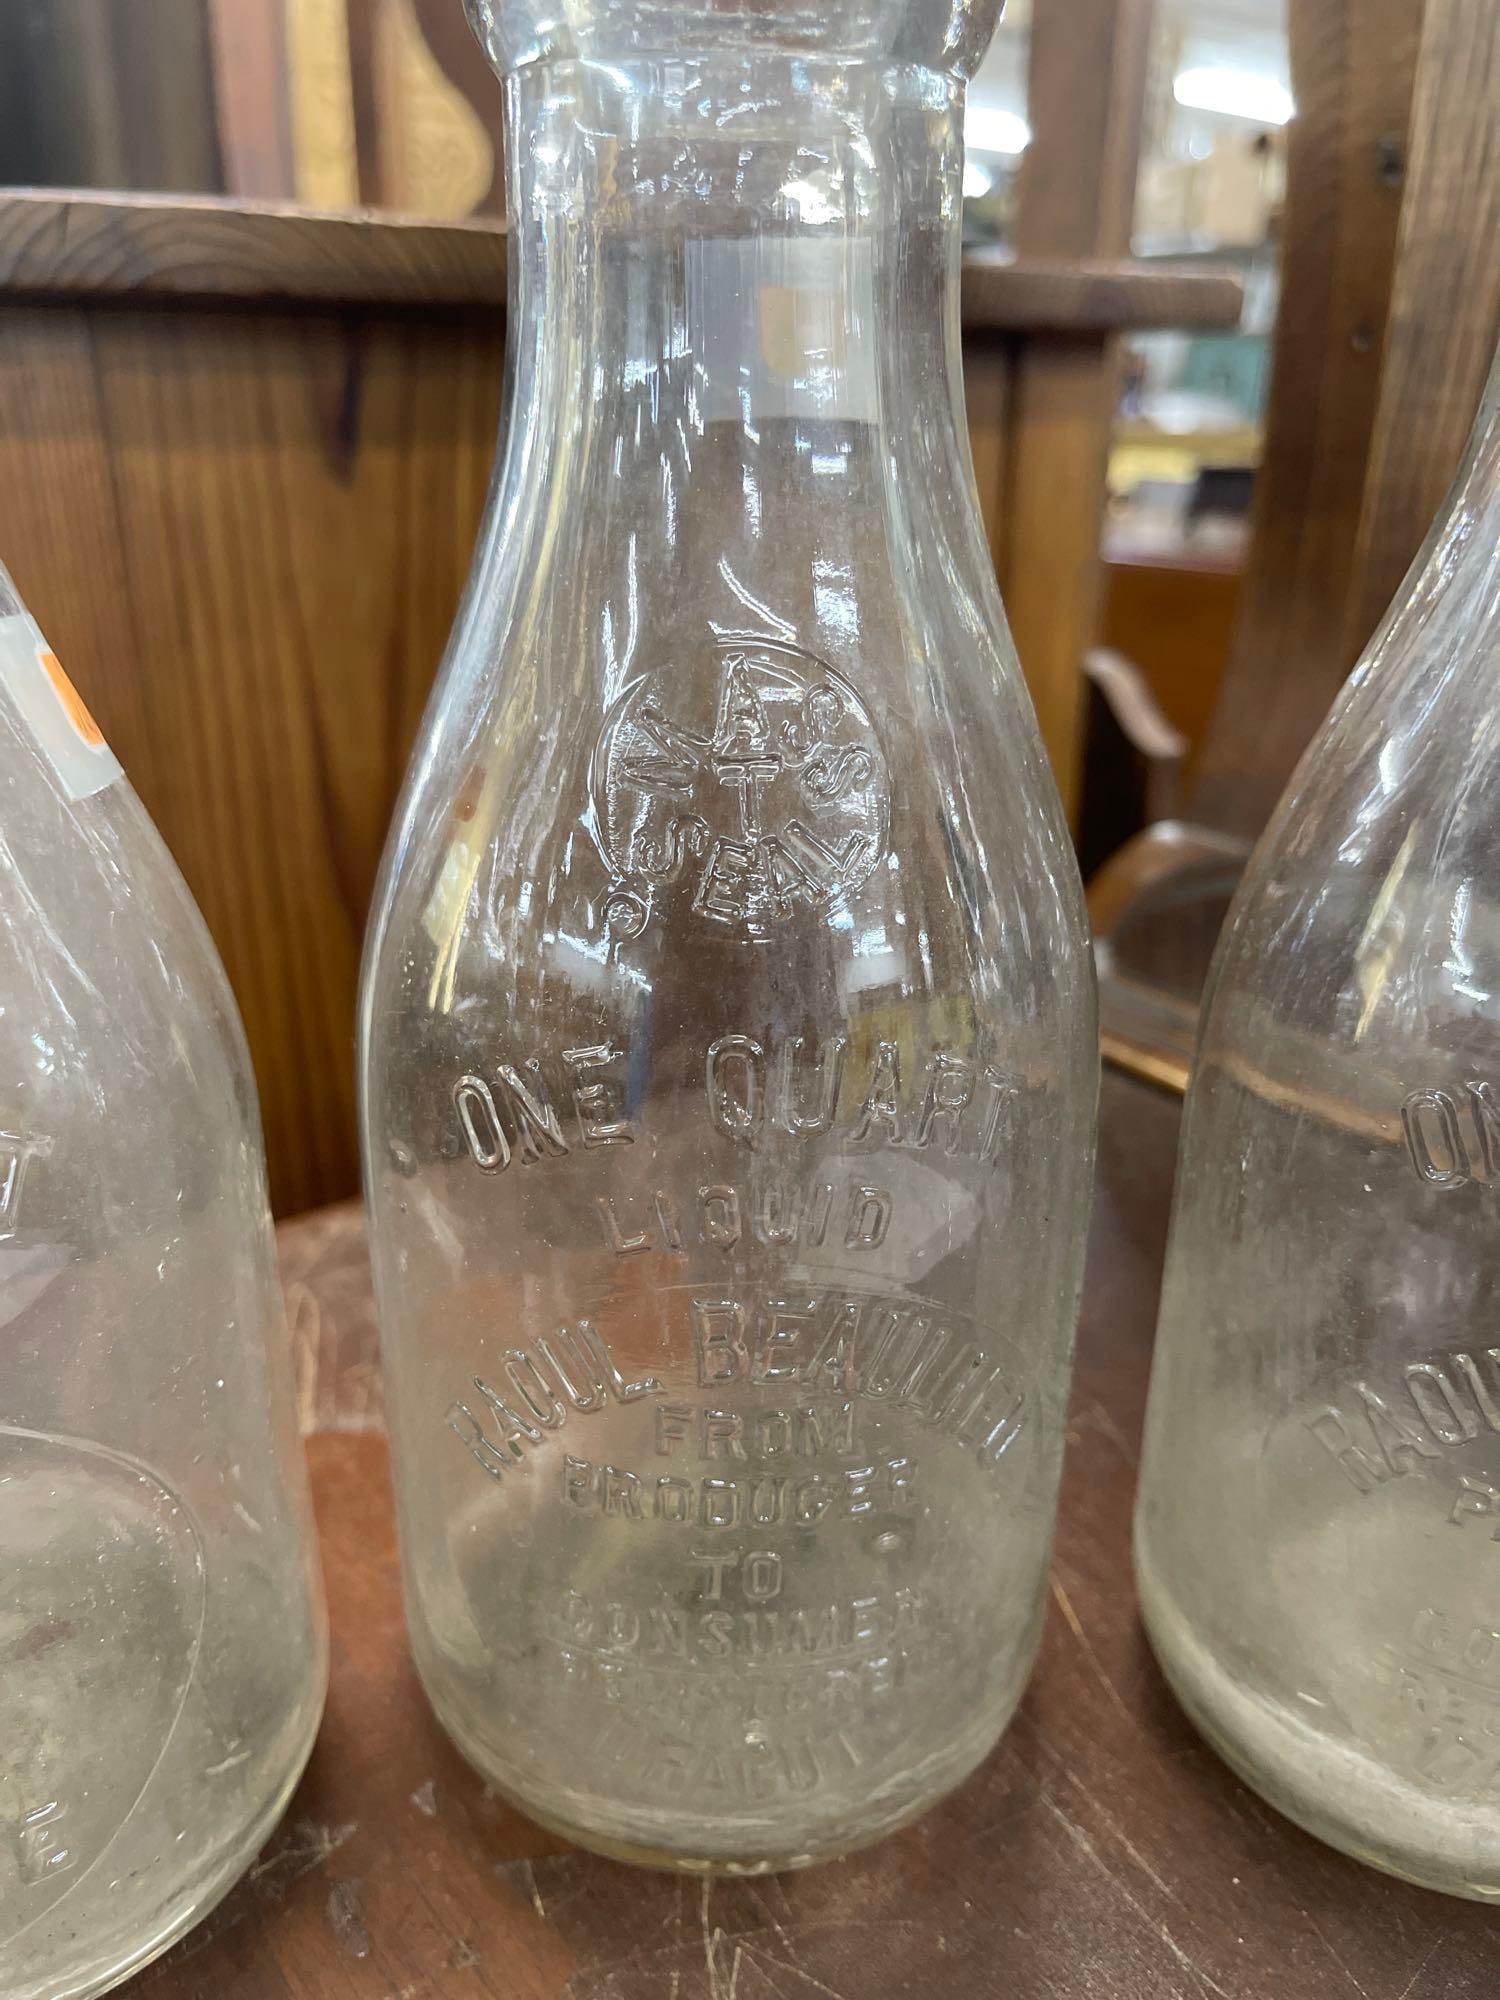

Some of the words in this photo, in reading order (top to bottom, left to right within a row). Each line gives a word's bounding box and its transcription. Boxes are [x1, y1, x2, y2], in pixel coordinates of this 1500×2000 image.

[452, 1042, 634, 1175] ONE
[704, 1033, 1023, 1162] QUART
[602, 1183, 891, 1257] LIQUID
[445, 1319, 668, 1482] RAOUL
[655, 1401, 859, 1461] FROM
[563, 1454, 919, 1531] PRODUCER
[691, 1551, 784, 1601] TO
